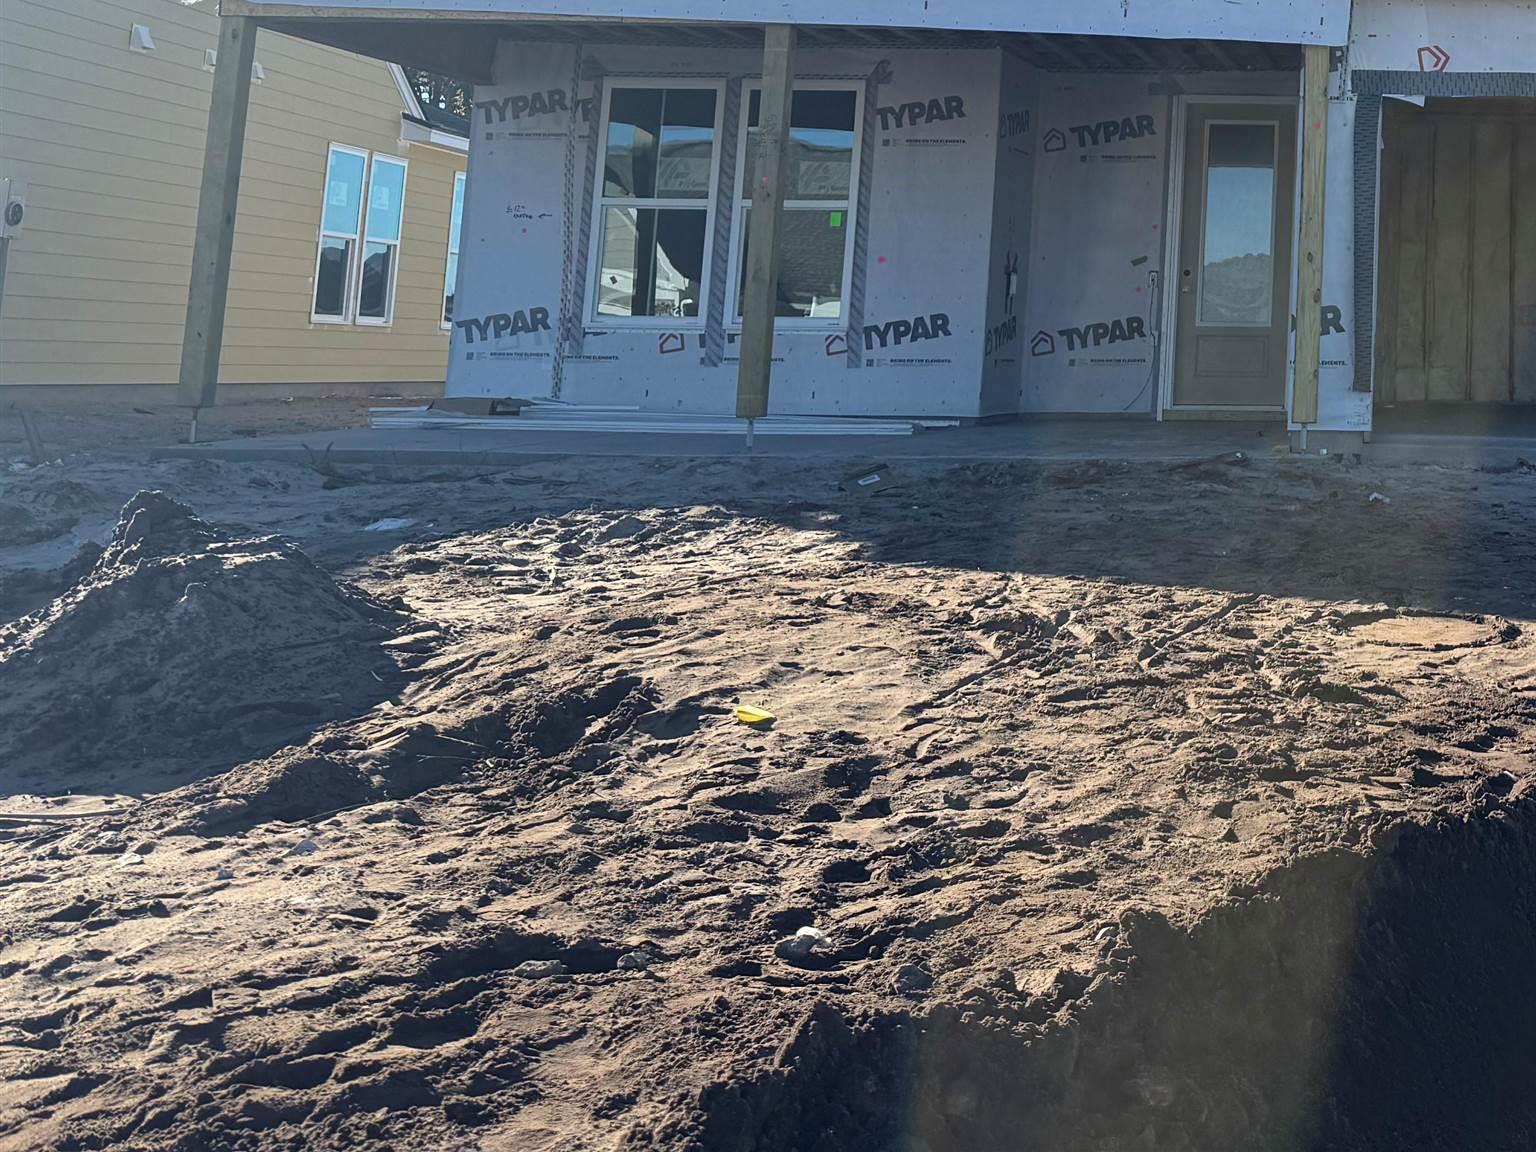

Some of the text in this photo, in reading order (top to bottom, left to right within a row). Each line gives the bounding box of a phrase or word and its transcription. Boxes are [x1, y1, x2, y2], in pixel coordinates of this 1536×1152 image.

[474, 88, 569, 125] TYPAR
[878, 95, 967, 131] TYPAR
[1070, 114, 1157, 148] TYPAR
[455, 306, 552, 344] TYPAR
[863, 312, 953, 350] TYPAR
[1057, 316, 1147, 351] TYPAR
